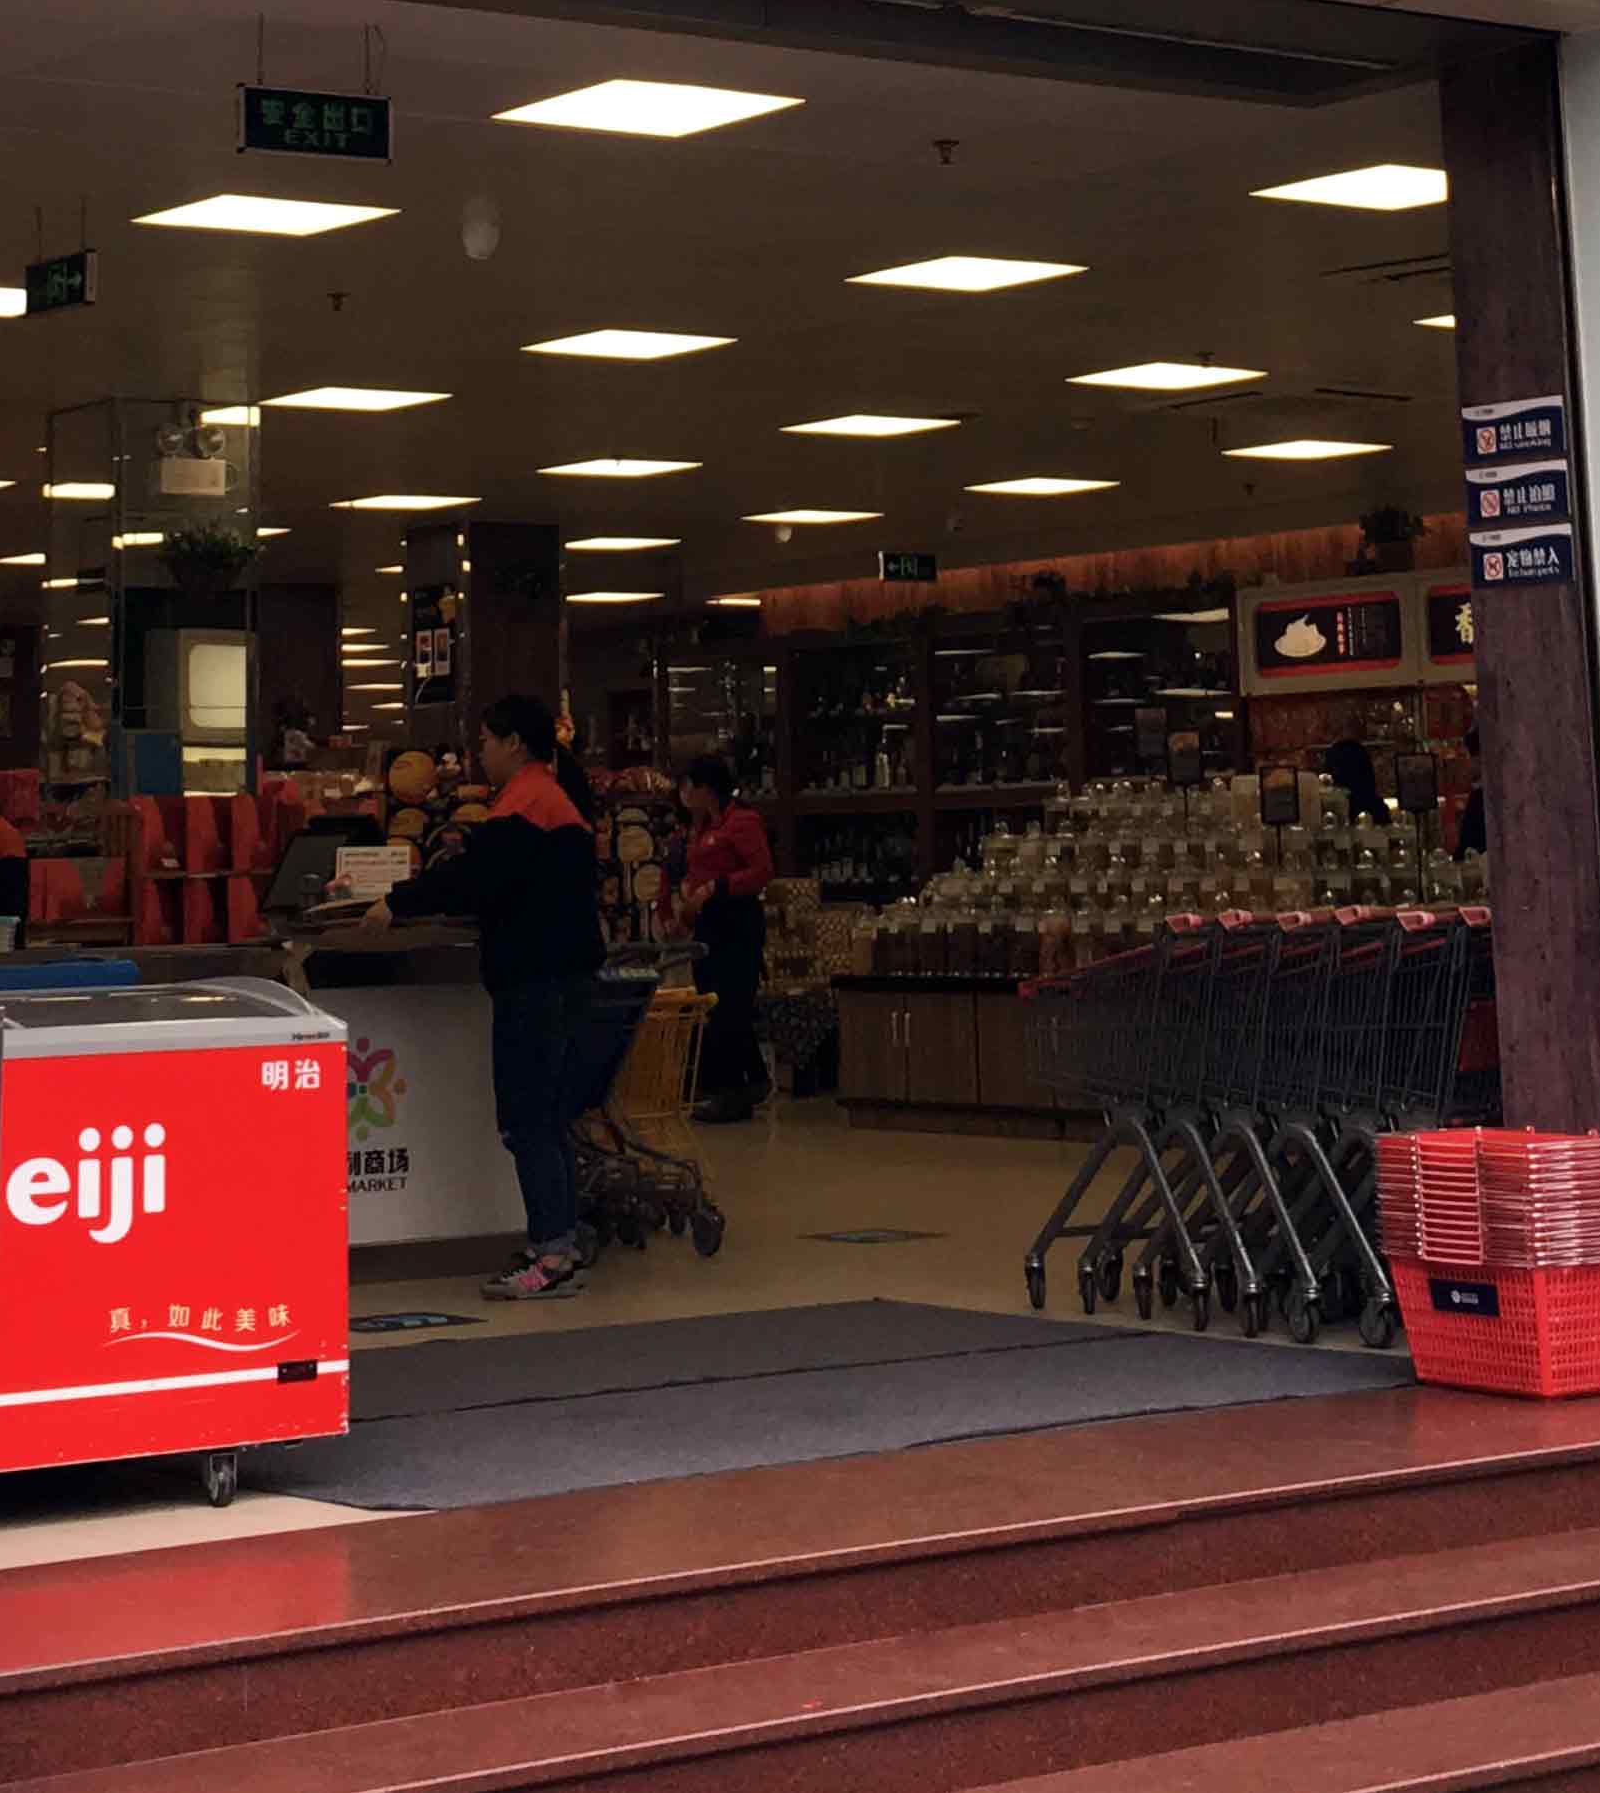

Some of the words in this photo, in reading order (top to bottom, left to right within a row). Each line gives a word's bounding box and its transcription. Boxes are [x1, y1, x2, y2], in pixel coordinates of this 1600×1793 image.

[260, 99, 373, 133] 安全出口
[284, 128, 351, 149] EXIT
[261, 1060, 322, 1091] 明治
